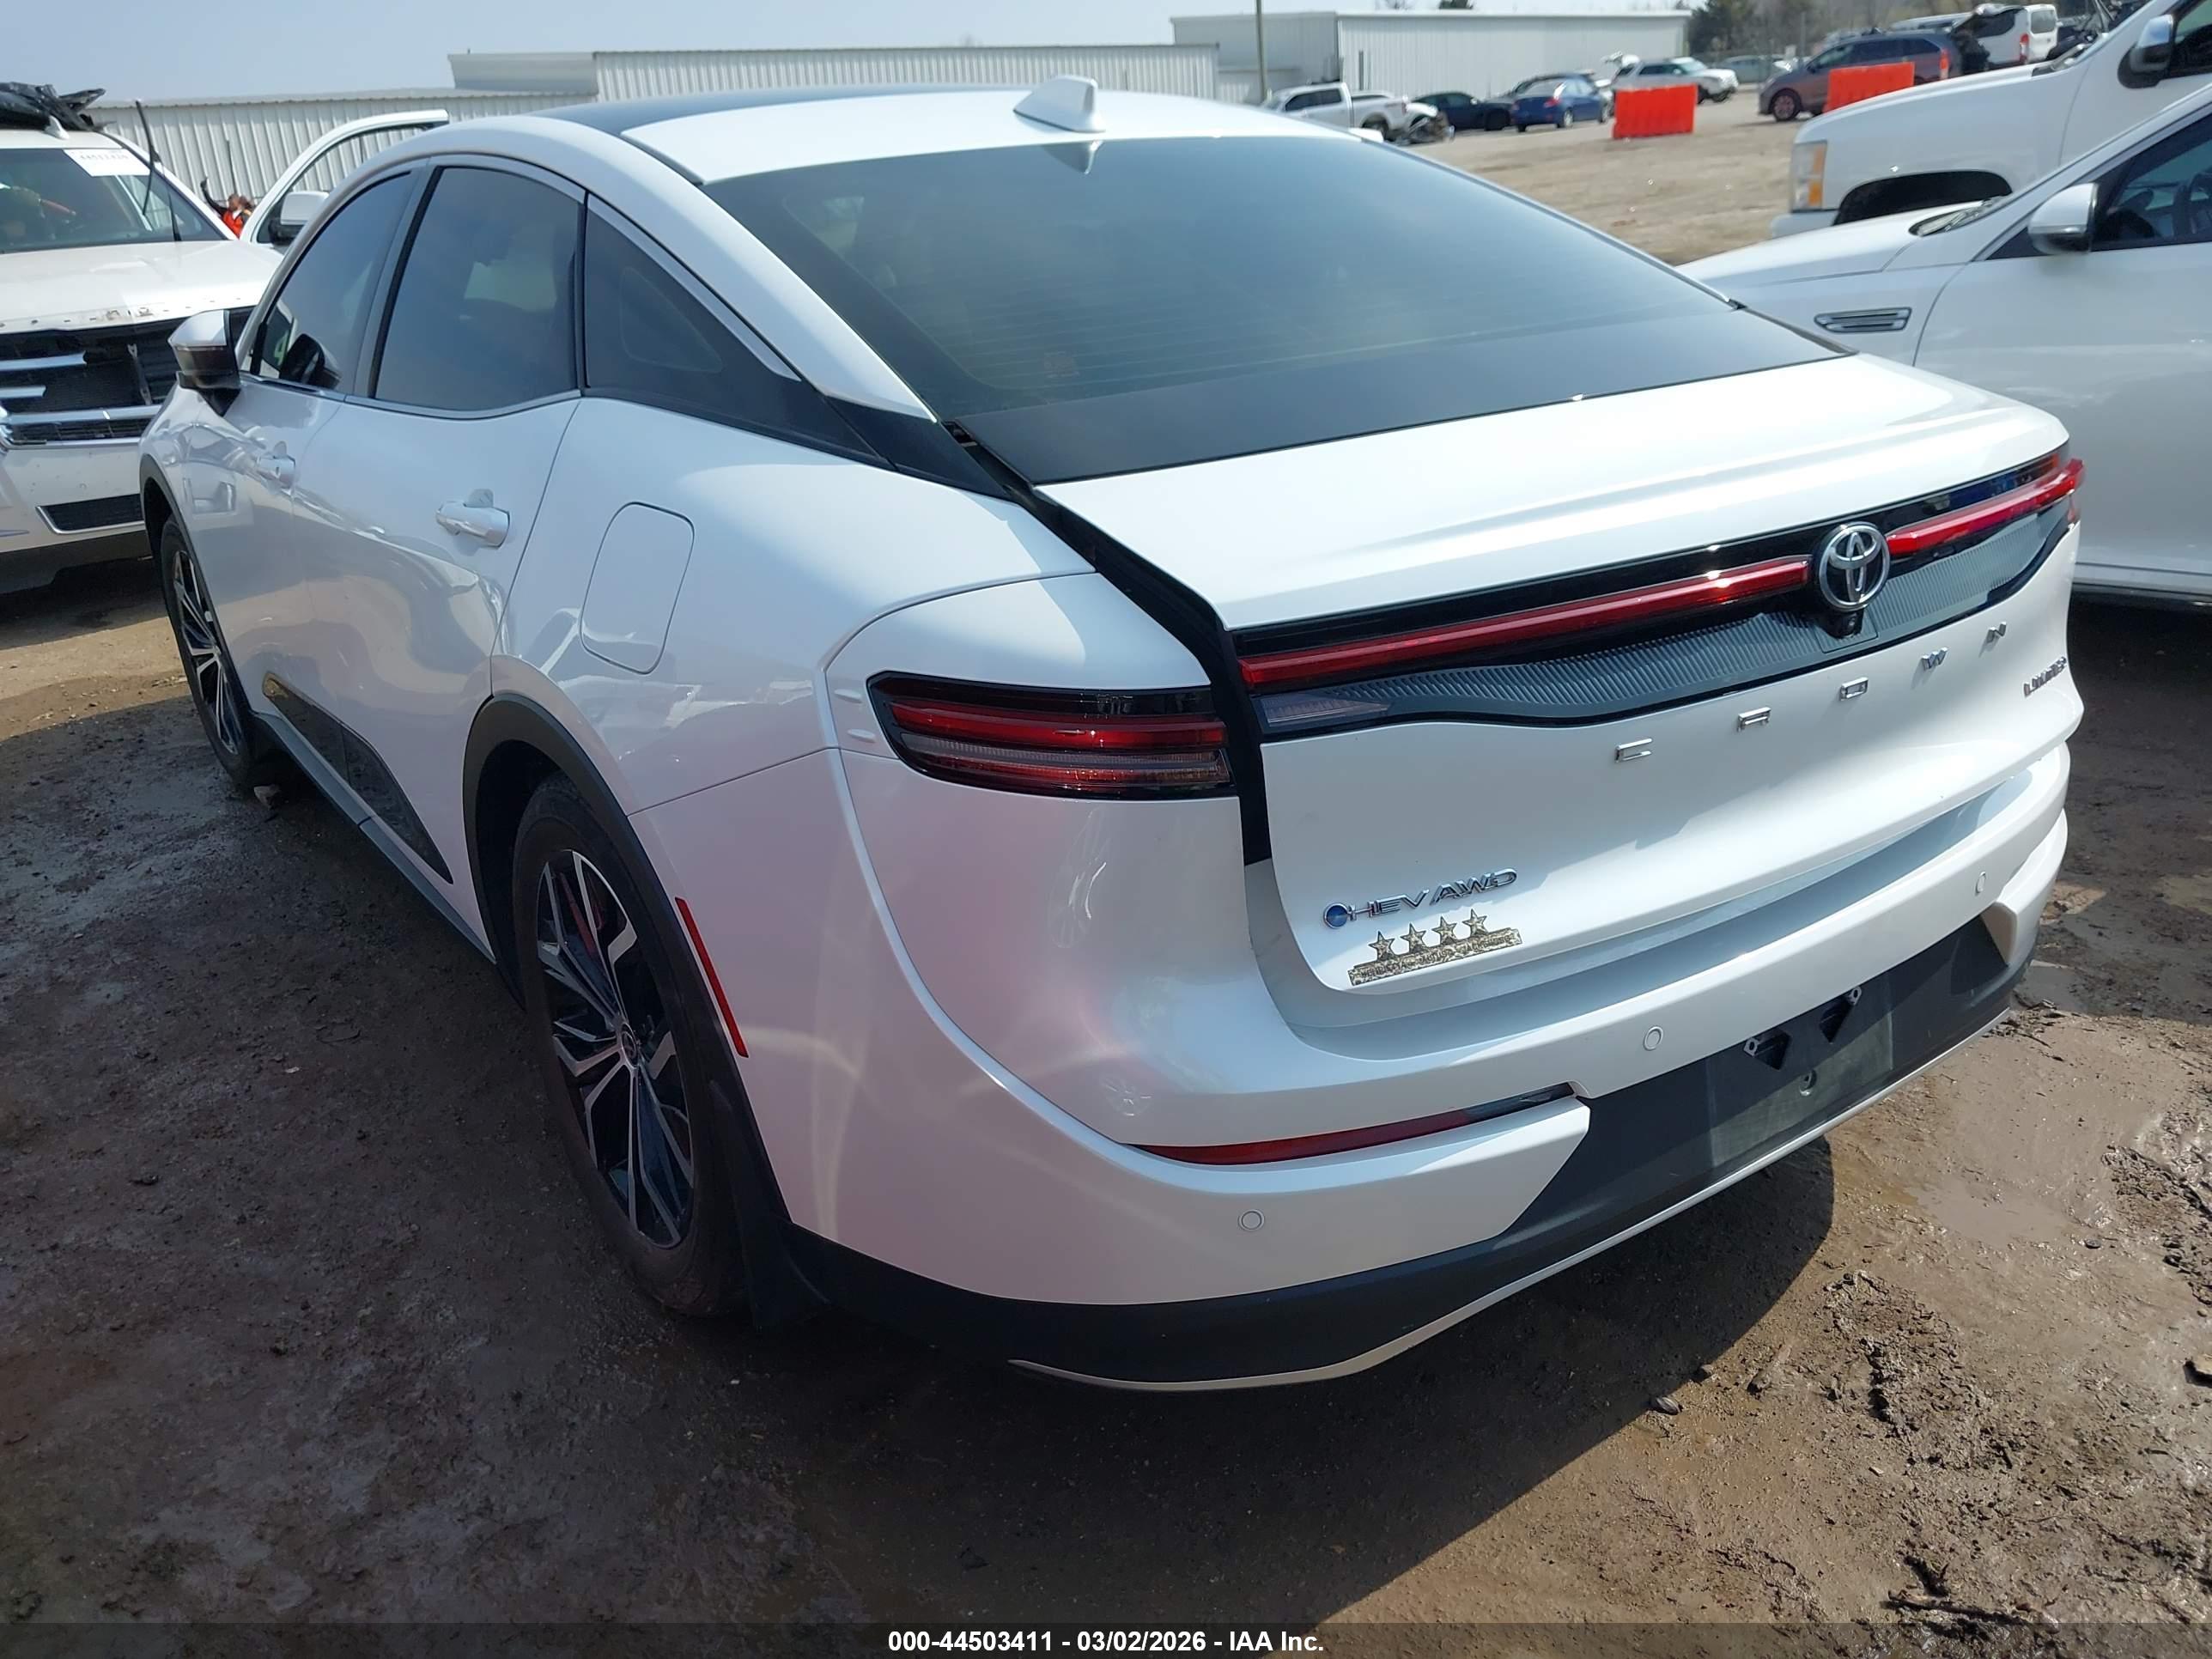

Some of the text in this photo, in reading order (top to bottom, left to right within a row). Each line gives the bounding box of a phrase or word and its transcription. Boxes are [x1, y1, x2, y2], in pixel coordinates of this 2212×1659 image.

[1615, 622, 2008, 763] CROWN
[1347, 868, 1517, 921] HEV AWD
